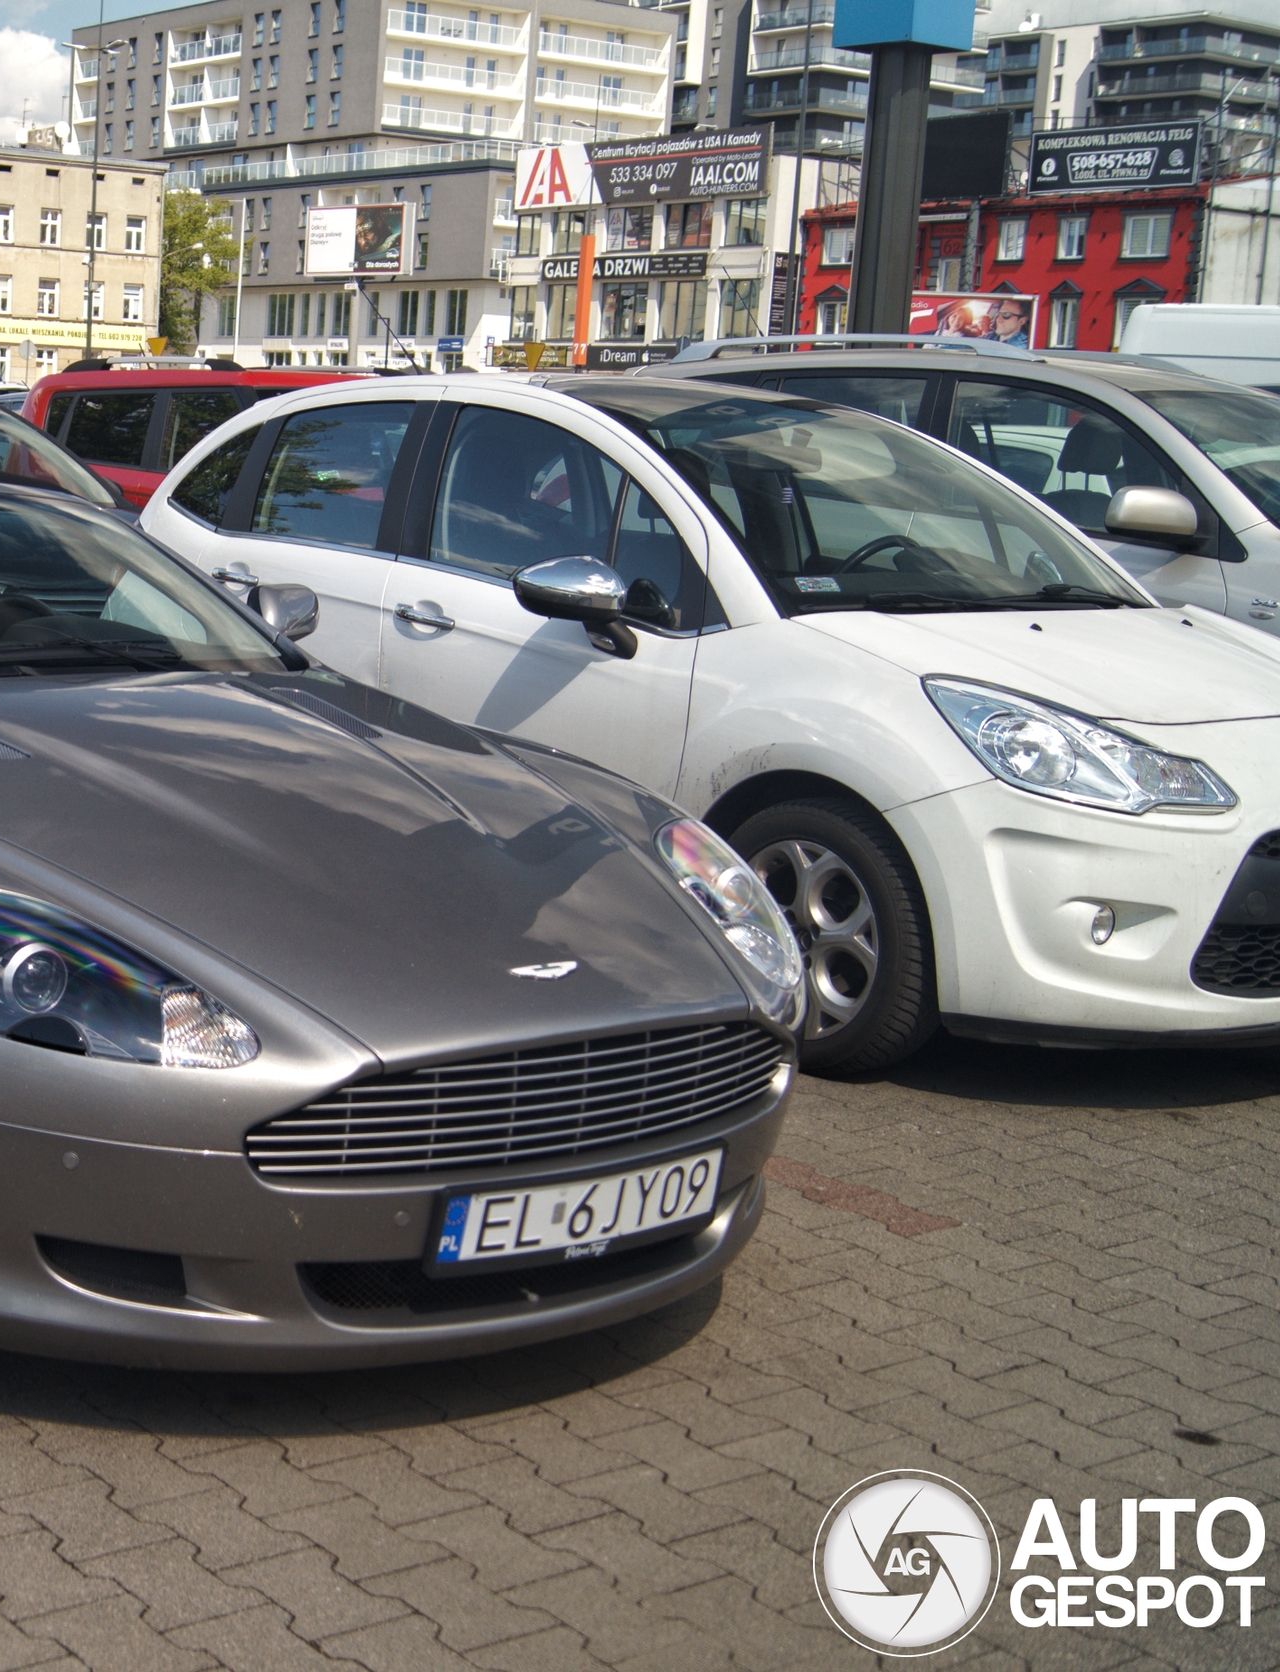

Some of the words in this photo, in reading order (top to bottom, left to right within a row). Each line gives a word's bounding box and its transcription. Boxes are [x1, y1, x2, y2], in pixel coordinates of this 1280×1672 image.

[592, 147, 624, 158] Centrum
[625, 142, 656, 157] licytacji
[656, 137, 696, 155] pojazdów
[698, 140, 704, 148] z
[705, 135, 720, 147] USA
[722, 134, 727, 145] i
[727, 131, 762, 146] Kanady
[1038, 134, 1106, 150] KOMPLEKSOWA
[1107, 130, 1167, 146] RENOWACJA
[1168, 127, 1194, 141] FELG
[691, 156, 718, 164] Operated
[1071, 151, 1152, 171] 508-657-628
[609, 166, 630, 183] 533
[632, 164, 653, 181] 334
[655, 162, 678, 179] 097
[689, 161, 760, 186] IAAI.COM
[1110, 167, 1138, 178] PIWNA
[1138, 167, 1149, 177] 22
[689, 182, 758, 196] AUTO-HUNTERS.COM
[544, 260, 601, 278] GALEA
[604, 257, 650, 276] DRZWI
[580, 343, 587, 354] 7
[600, 348, 637, 362] iDream
[475, 1193, 541, 1254] EL
[567, 1158, 710, 1240] 6JY09
[439, 1234, 458, 1252] PL
